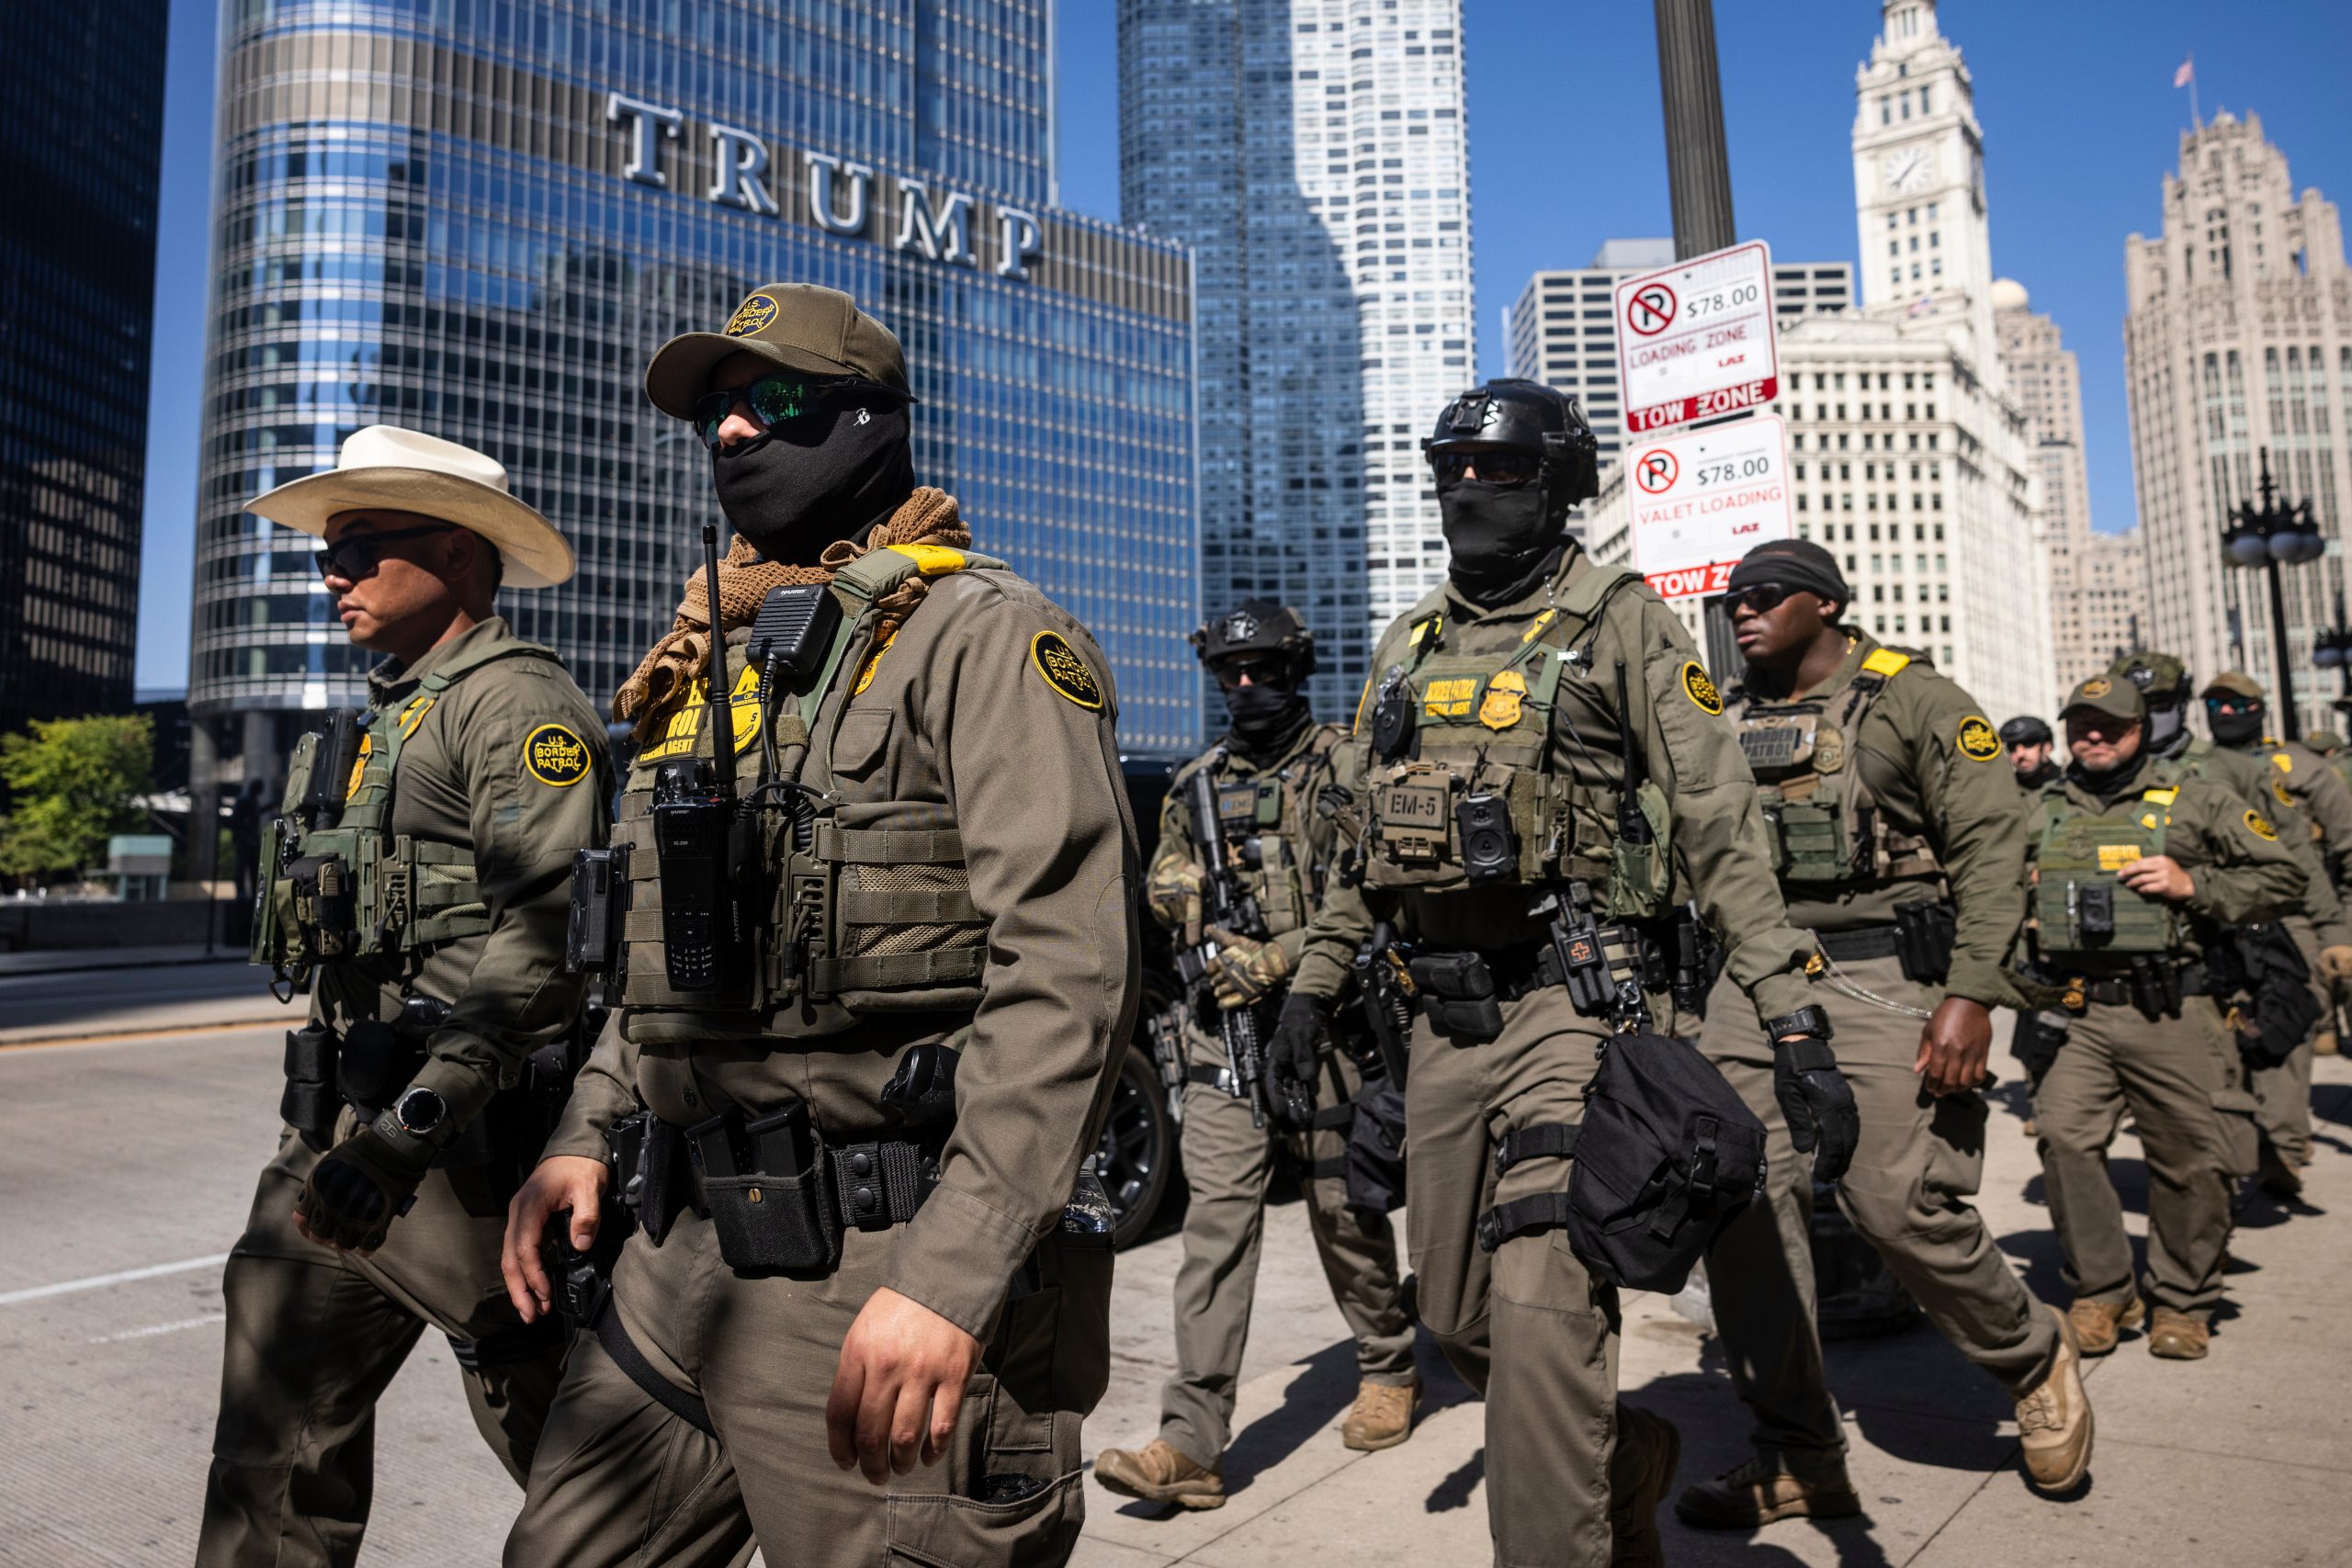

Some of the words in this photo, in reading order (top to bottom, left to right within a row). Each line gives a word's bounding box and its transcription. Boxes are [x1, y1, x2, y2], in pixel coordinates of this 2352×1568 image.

[606, 91, 1044, 281] TRUMP
[1687, 284, 1758, 319] $78.00
[1630, 337, 1696, 369] LOADING
[1706, 324, 1747, 350] ZONE
[1634, 400, 1685, 431] TOW
[1696, 381, 1767, 415] ZONE
[1697, 456, 1770, 486] $78.00
[1639, 502, 1694, 525] VALET
[1700, 486, 1782, 515] LOADING
[1649, 570, 1706, 596] TOW
[537, 748, 579, 758] BORDER
[548, 735, 567, 746] U.S.
[666, 739, 695, 755] AGENT
[1744, 744, 1790, 757] PATROL
[537, 758, 582, 769] PATROL
[1390, 793, 1437, 817] EM-5
